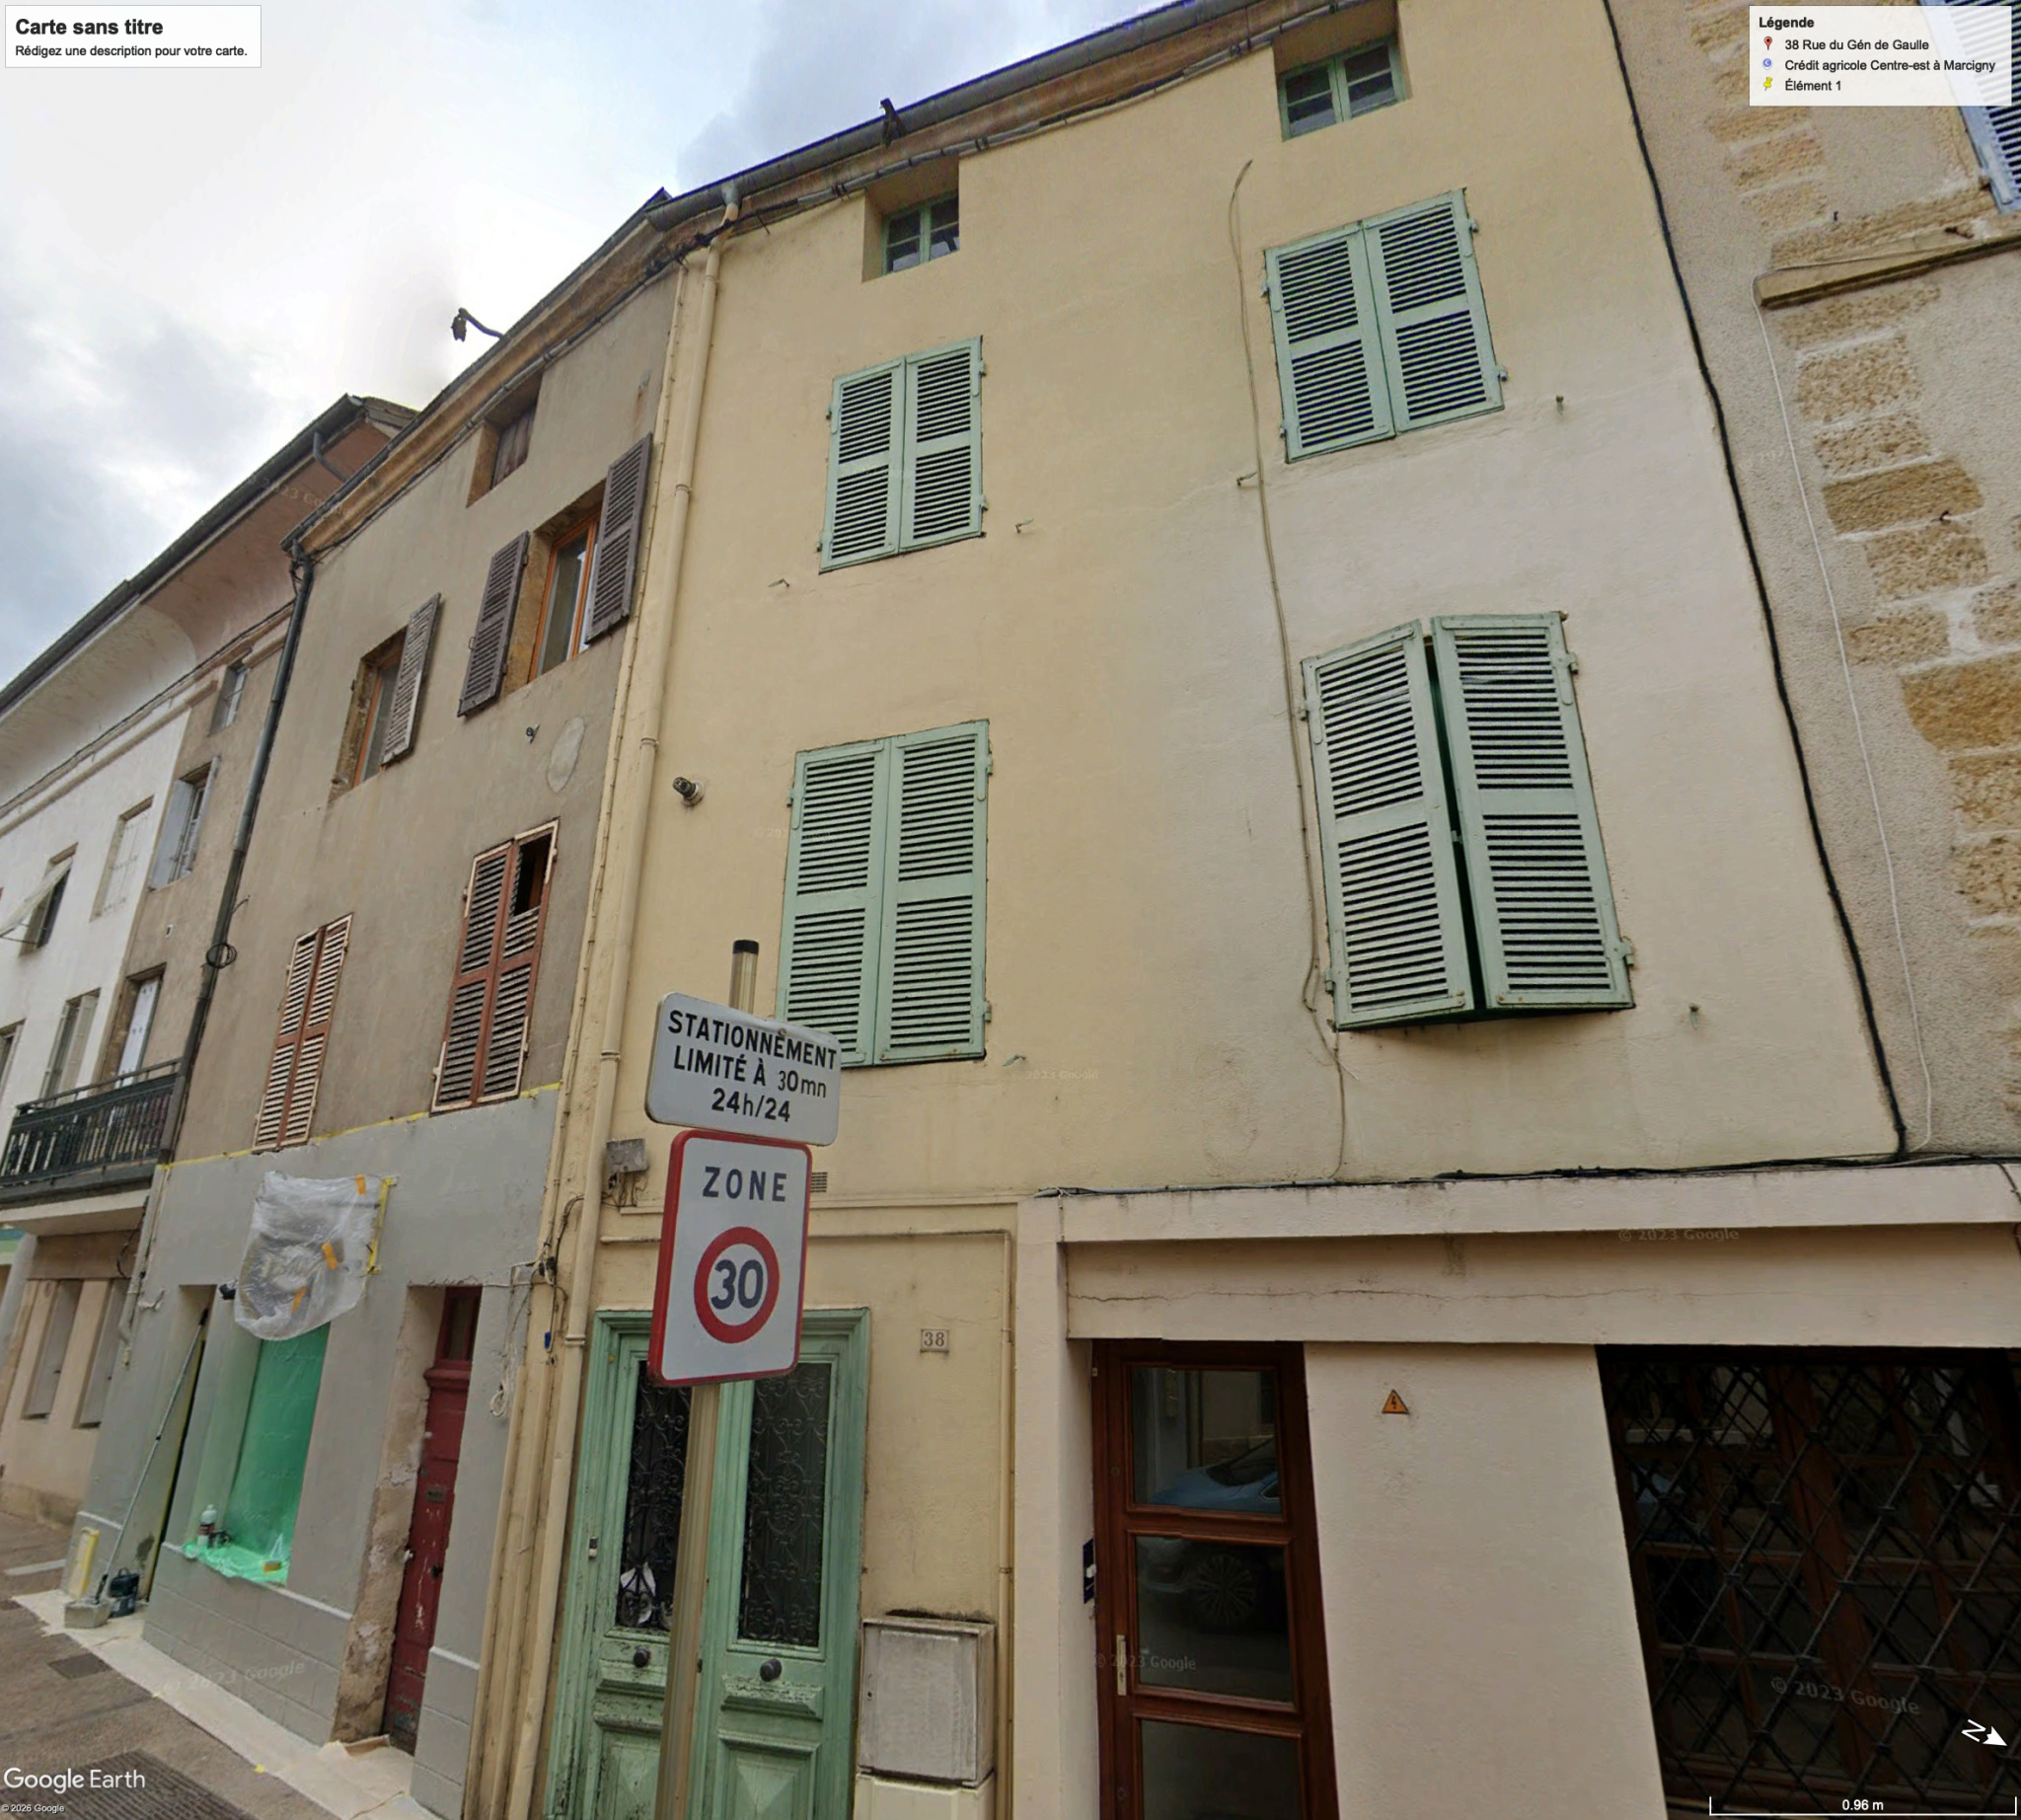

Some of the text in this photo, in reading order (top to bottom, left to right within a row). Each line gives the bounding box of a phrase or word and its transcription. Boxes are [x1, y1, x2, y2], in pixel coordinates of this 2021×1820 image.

[667, 1009, 838, 1070] STATIONNEMENT
[673, 1044, 827, 1099] LIMITÉ À 30mn
[711, 1088, 791, 1123] 24h/24
[702, 1166, 787, 1202] ZONE
[711, 1258, 764, 1311] 30
[924, 1331, 945, 1347] 38
